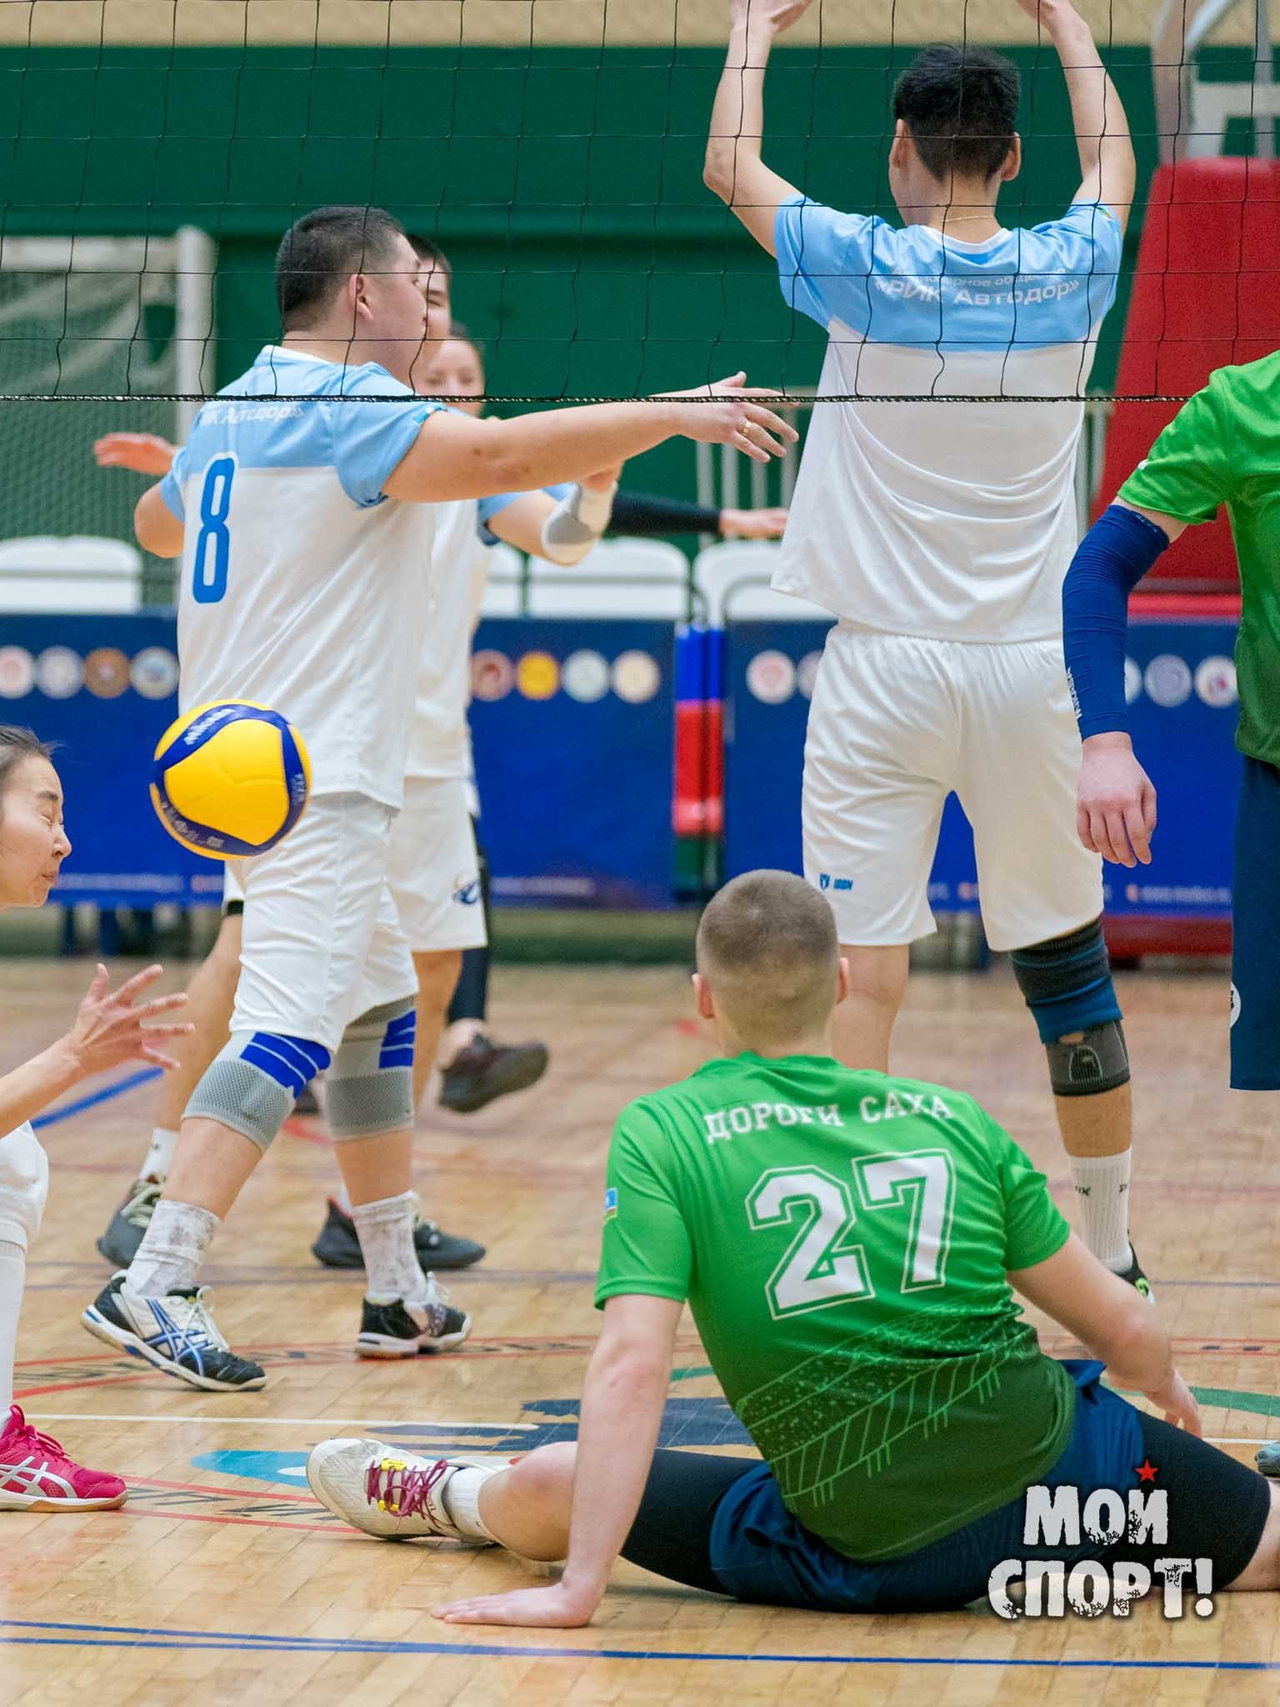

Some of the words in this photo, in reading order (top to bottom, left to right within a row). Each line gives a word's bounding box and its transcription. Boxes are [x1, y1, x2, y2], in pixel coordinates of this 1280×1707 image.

[953, 278, 1080, 306] Автодор»
[192, 453, 236, 605] 8
[703, 1102, 845, 1144] ДОРОГИ
[859, 1090, 954, 1124] САХА
[745, 1147, 958, 1321] 27
